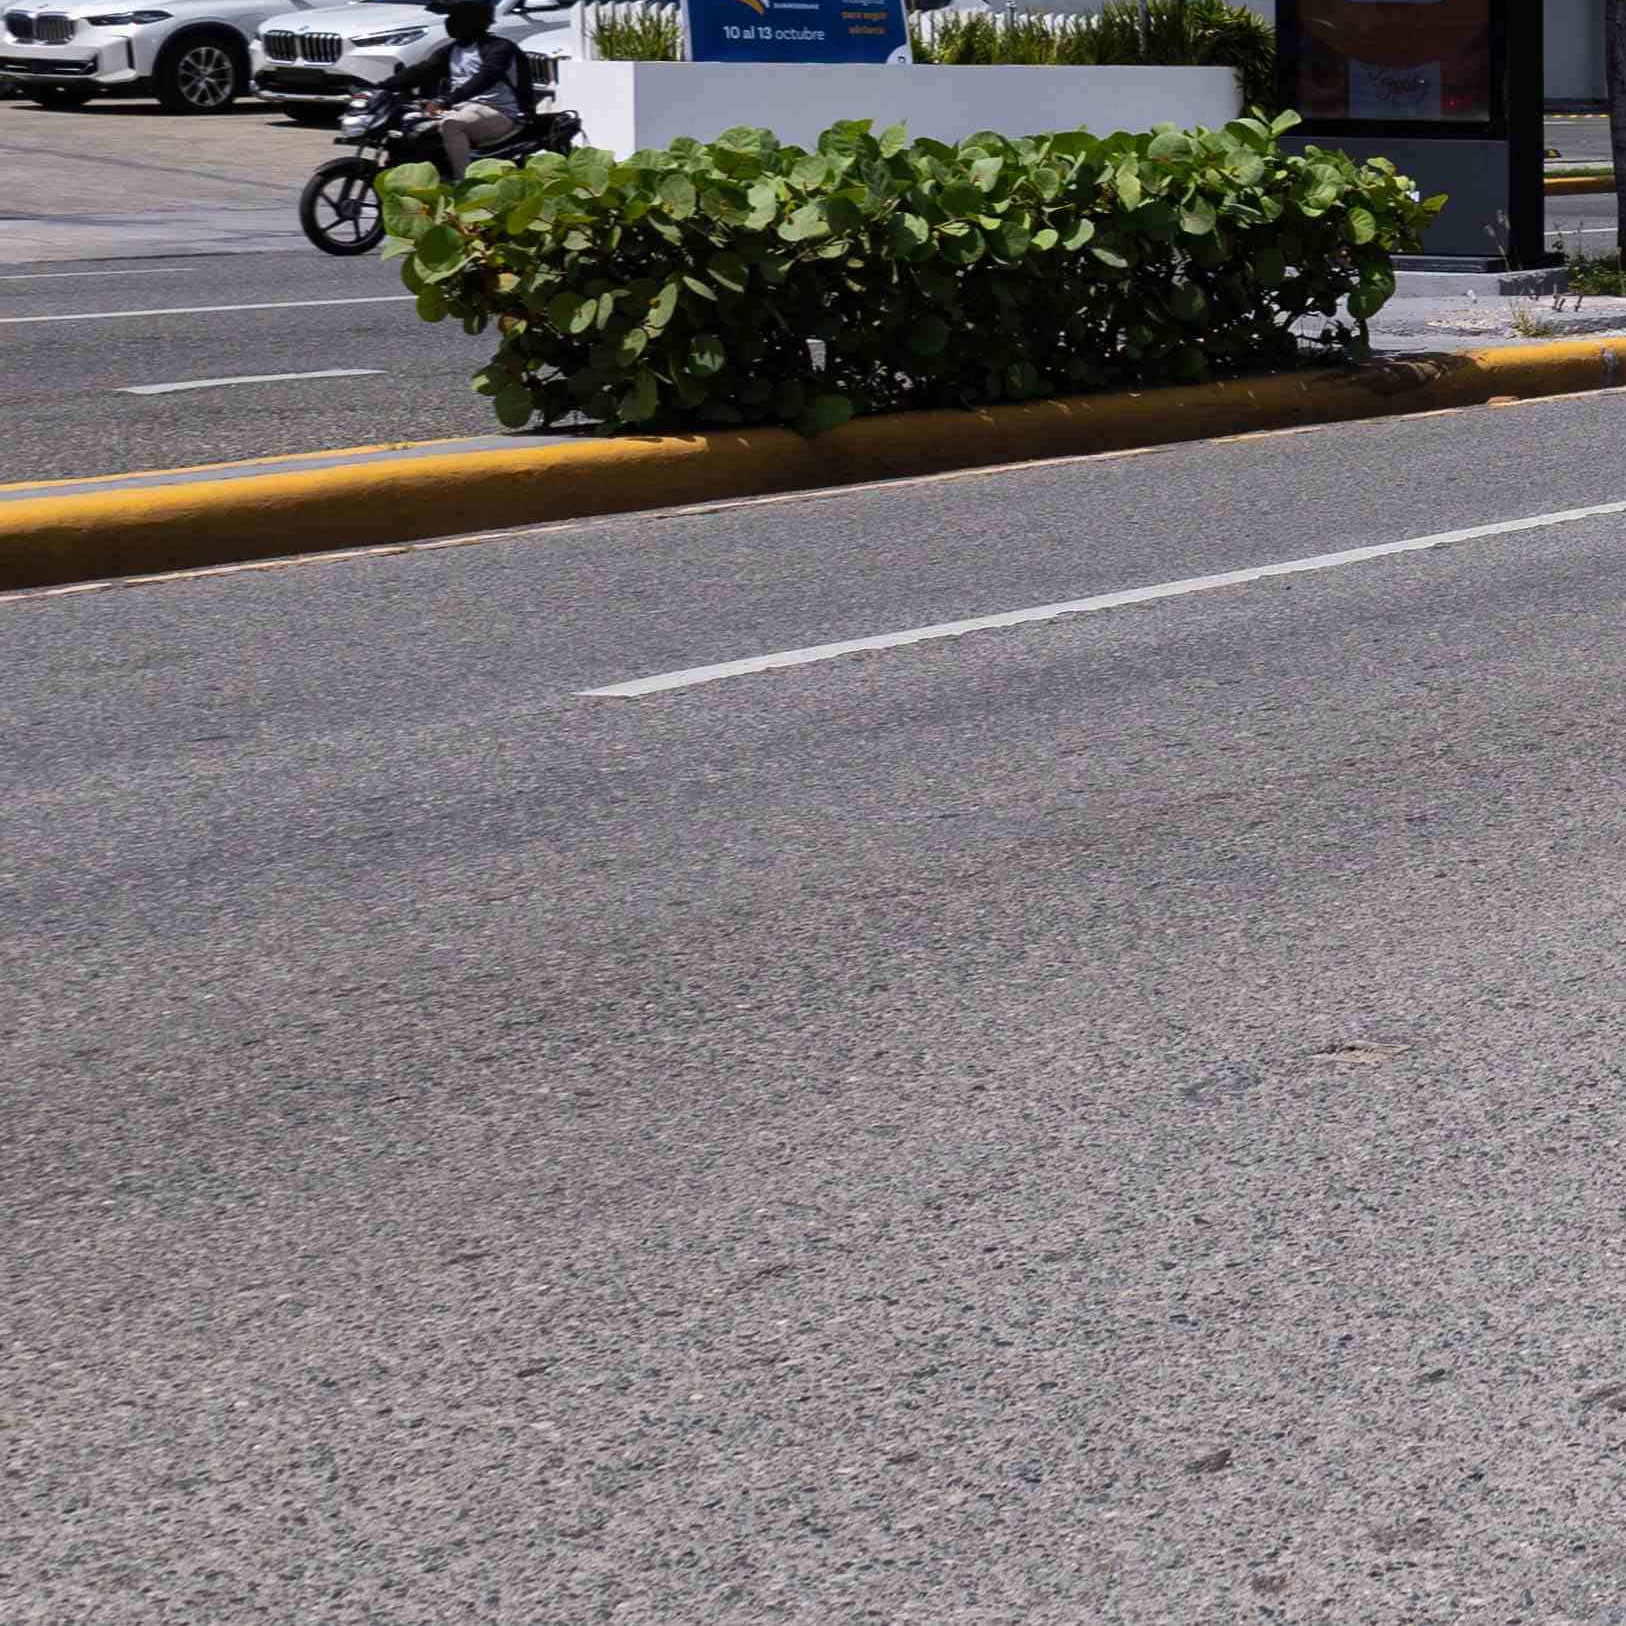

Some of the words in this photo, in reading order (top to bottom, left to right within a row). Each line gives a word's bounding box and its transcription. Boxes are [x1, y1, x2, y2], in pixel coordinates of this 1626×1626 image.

[723, 26, 740, 40] 10
[742, 26, 755, 40] al
[757, 26, 773, 40] 13
[775, 26, 826, 41] octubre
